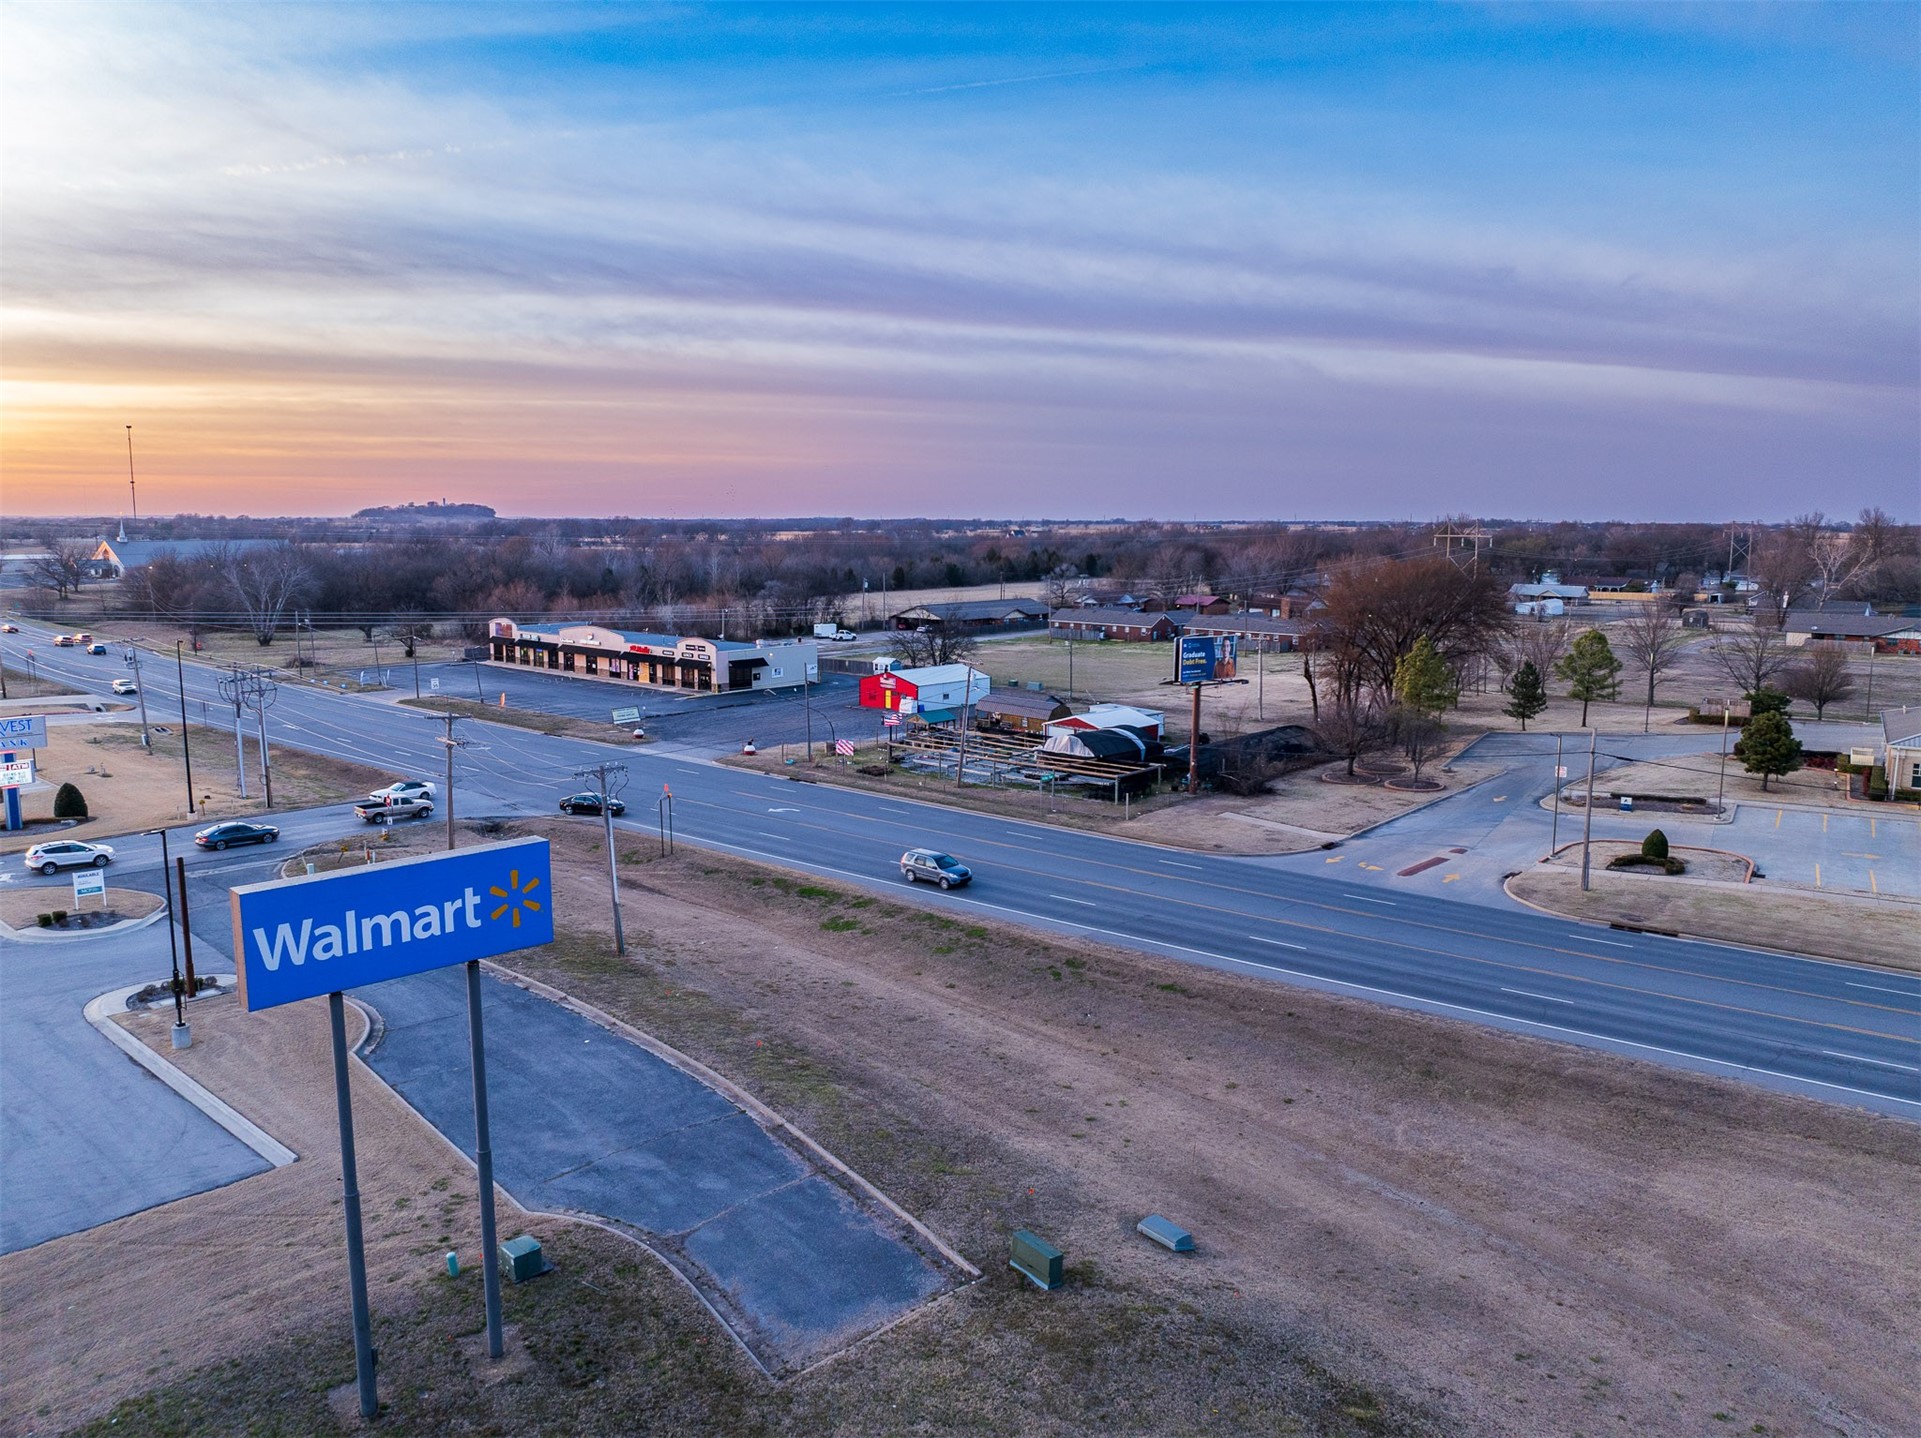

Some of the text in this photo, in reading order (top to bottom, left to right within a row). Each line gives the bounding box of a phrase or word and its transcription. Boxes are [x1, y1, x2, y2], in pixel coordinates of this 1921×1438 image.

[1183, 651, 1206, 659] Graduate
[0, 719, 32, 735] VEST
[253, 887, 481, 971] Walmart
